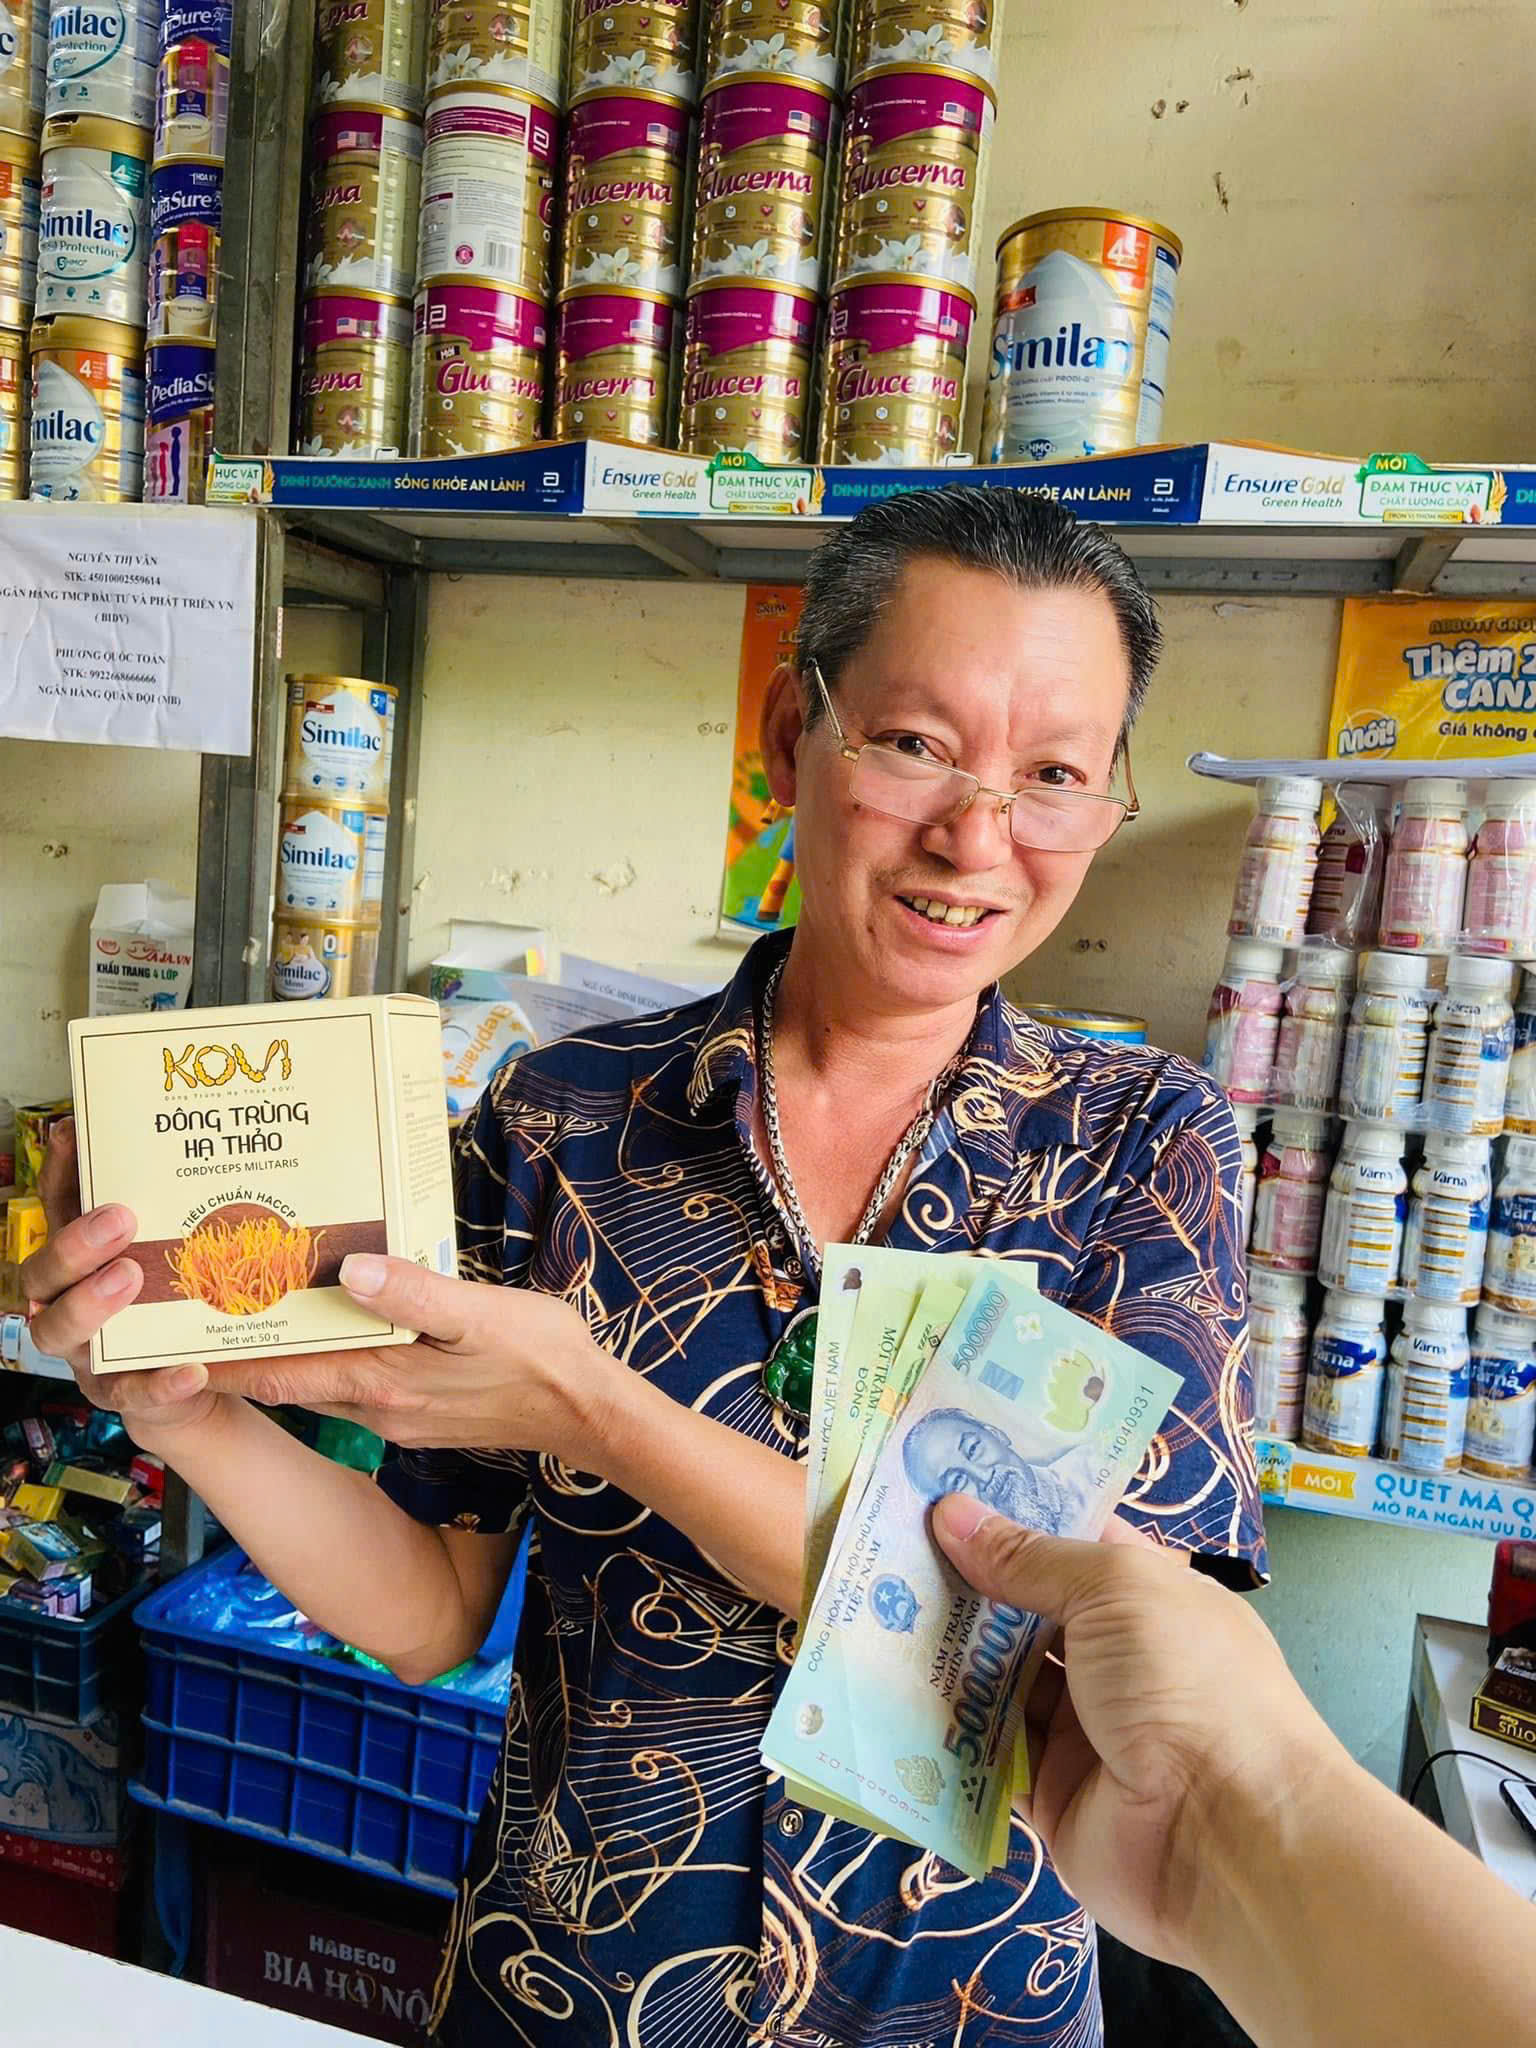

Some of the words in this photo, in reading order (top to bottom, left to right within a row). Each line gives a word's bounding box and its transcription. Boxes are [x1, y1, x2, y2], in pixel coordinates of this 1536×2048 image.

[79, 360, 92, 377] 4
[393, 472, 429, 489] SỐNG
[432, 475, 468, 491] KHỎE
[469, 479, 489, 491] AN
[490, 476, 526, 492] LÀNH
[602, 467, 661, 488] Ensure
[1224, 473, 1298, 495] Ensure
[631, 489, 662, 500] Green
[663, 489, 697, 501] Health
[1062, 487, 1085, 501] AN
[1087, 484, 1131, 502] LÀNH
[1261, 496, 1298, 508] Green
[1300, 495, 1343, 508] Health
[64, 571, 86, 582] STK:
[218, 599, 234, 610] VN
[1496, 618, 1536, 633] GRO
[1404, 639, 1514, 679] Thêm
[301, 719, 381, 752] Similac
[1338, 718, 1396, 756] Mới!
[1439, 721, 1467, 737] Giá
[1473, 722, 1528, 742] không
[280, 841, 357, 871] Similac
[121, 964, 151, 978] TRANG
[274, 961, 321, 982] Similac
[162, 1039, 293, 1092] KOVI
[184, 1137, 215, 1162] HẠ
[221, 1127, 283, 1156] THẢO
[176, 1163, 242, 1178] CORDYCEPS
[244, 1158, 300, 1172] MILITARIS
[181, 1203, 207, 1230] TIÊU
[207, 1184, 253, 1208] CHUẨN
[256, 1190, 298, 1220] HACCP
[206, 1323, 234, 1335] Made
[235, 1322, 245, 1332] in
[222, 1336, 240, 1346] Net
[258, 1332, 271, 1343] 50
[272, 1333, 280, 1343] g
[825, 1341, 841, 1376] NAM
[1108, 1384, 1155, 1461] 14040931
[1375, 1472, 1453, 1504] QUÉT
[1459, 1487, 1503, 1513] MÃ
[1406, 1505, 1429, 1521] RA
[807, 1628, 830, 1673] CỘNG
[825, 1596, 844, 1629] HÒA
[837, 1576, 851, 1597] XÃ
[855, 1523, 872, 1552] CHỦ
[867, 1484, 889, 1524] NGHĨA
[841, 1583, 865, 1625] VIỆT
[860, 1539, 882, 1581] NAM
[929, 1647, 949, 1689] NĂM
[942, 1594, 968, 1645] TRĂM
[940, 1650, 965, 1704] NGHÌN
[958, 1599, 982, 1647] ĐỒNG
[308, 1934, 397, 1975] HABECO
[263, 1949, 315, 1993] BIA
